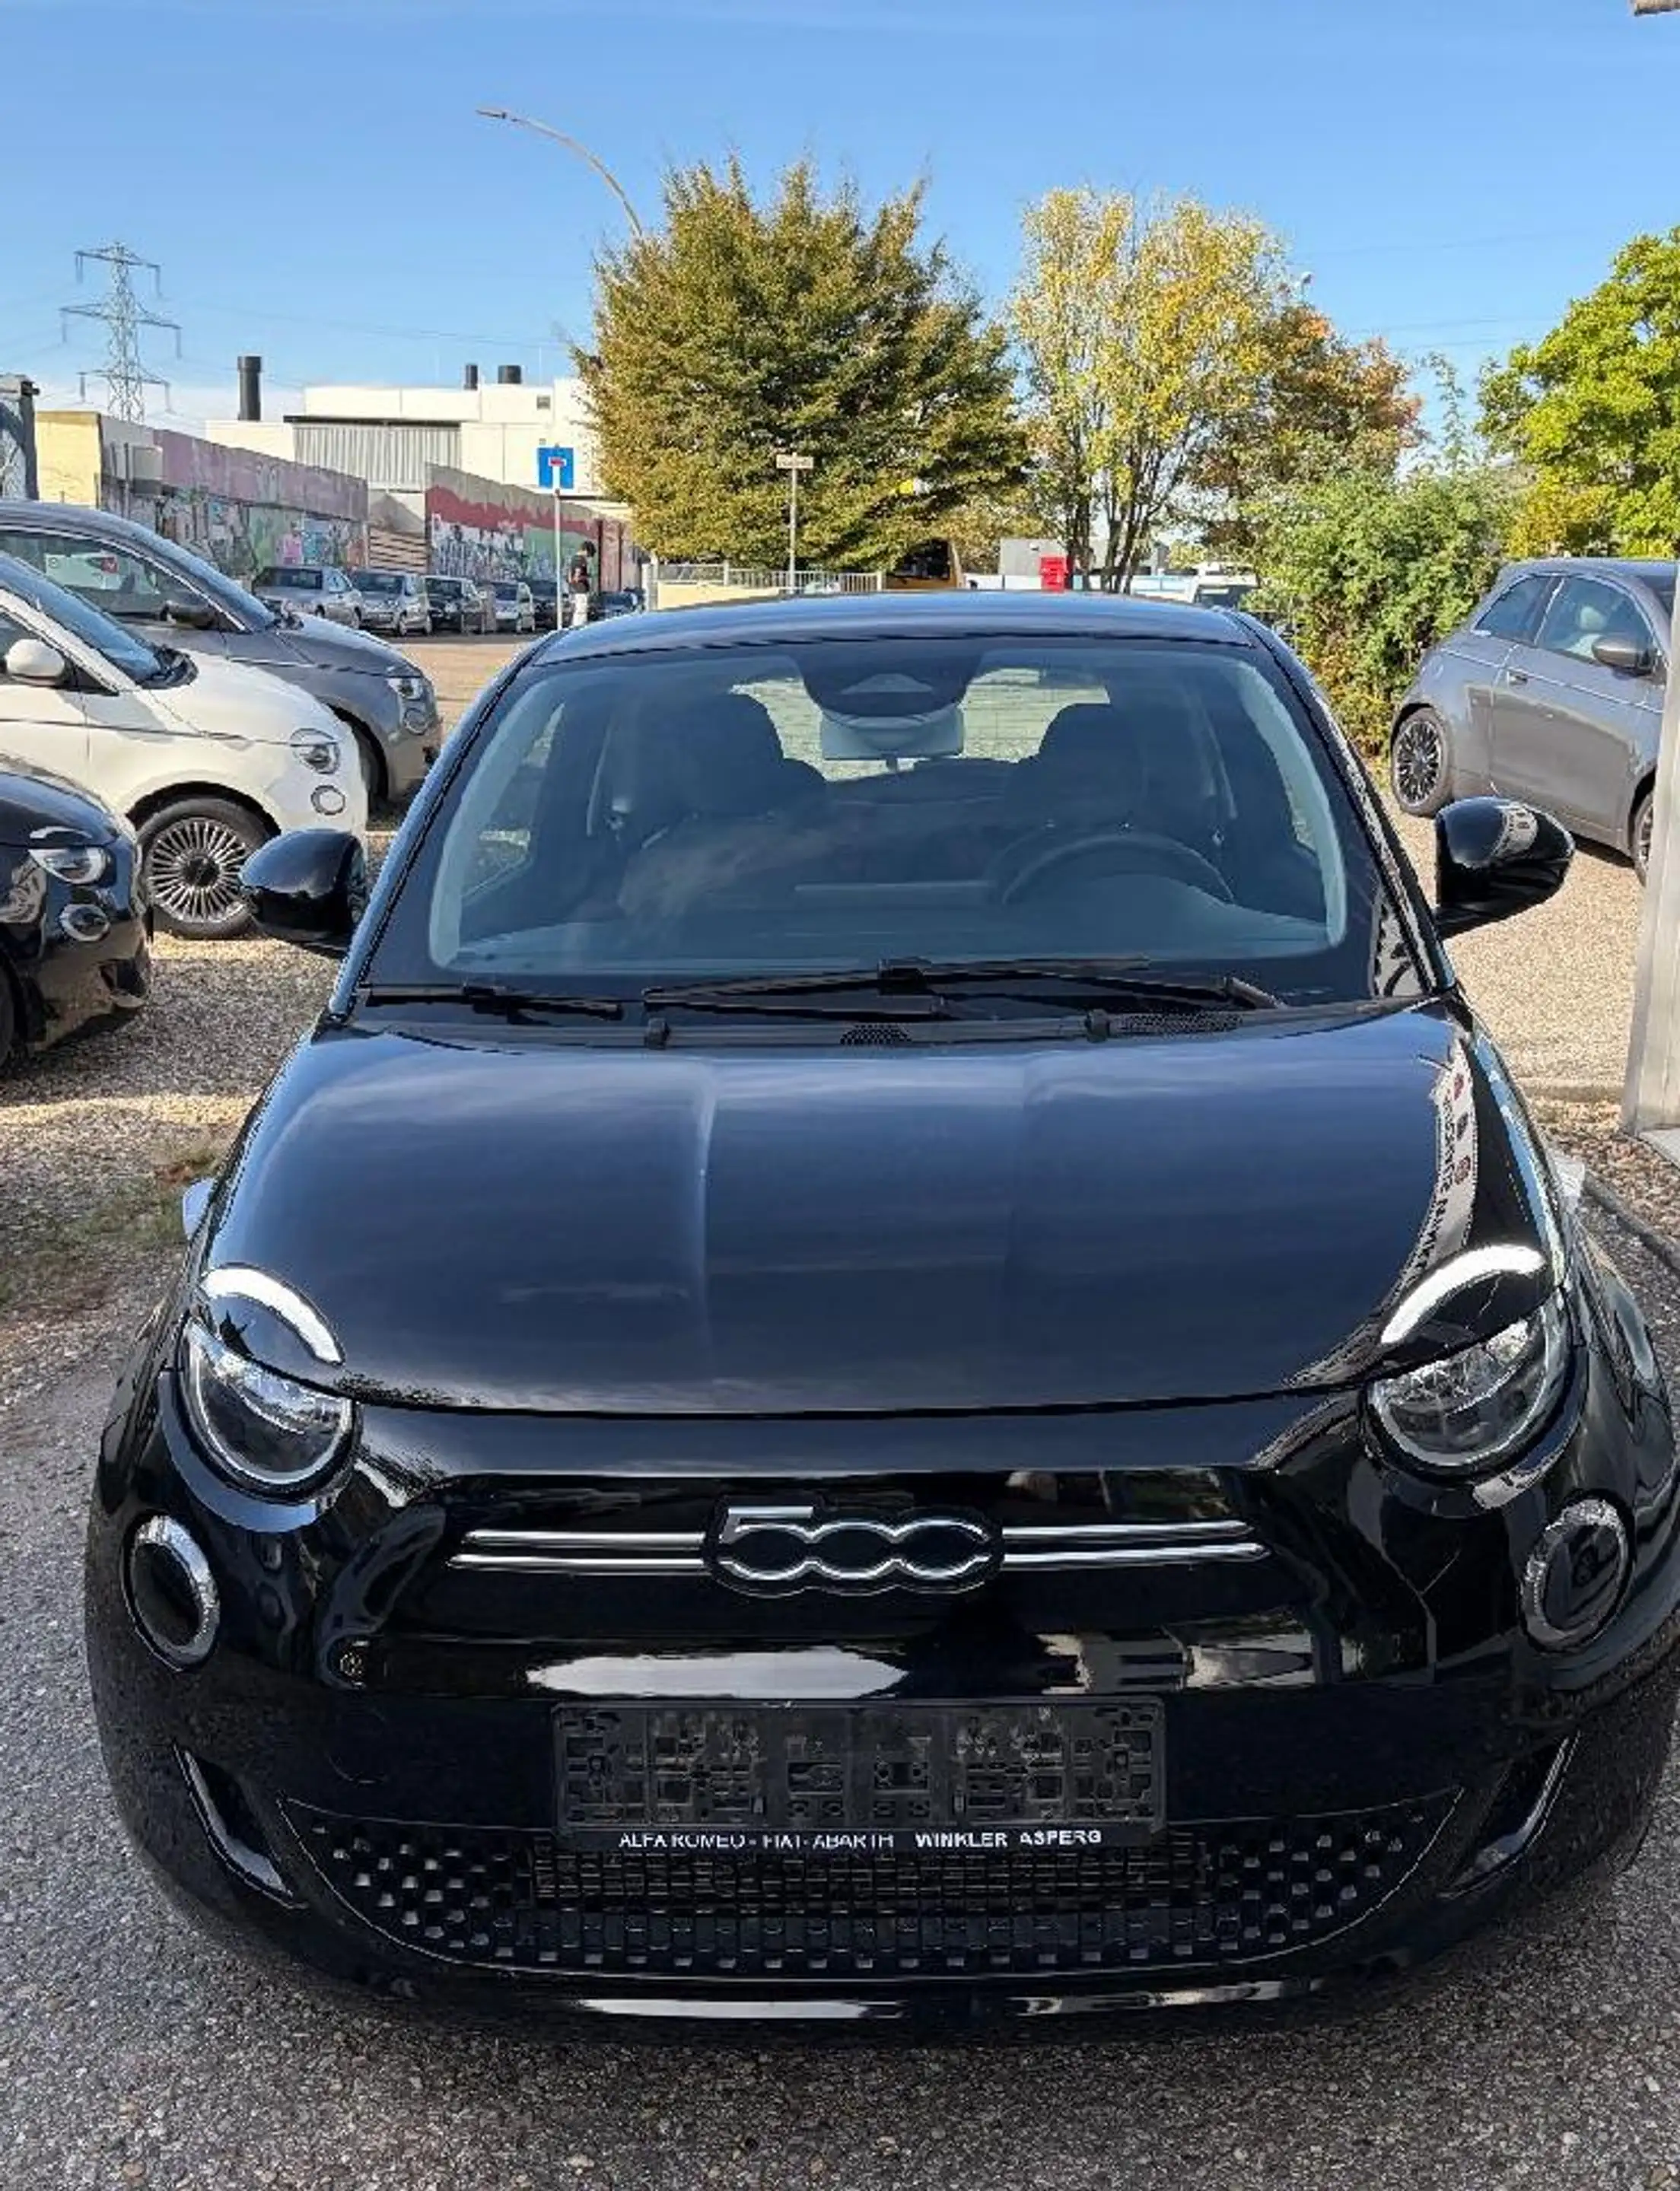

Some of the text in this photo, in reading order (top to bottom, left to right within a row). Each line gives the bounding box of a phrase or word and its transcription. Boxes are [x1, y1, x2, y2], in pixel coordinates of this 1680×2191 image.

[719, 1506, 991, 1580] 500
[619, 1833, 667, 1848] ALFA
[671, 1833, 745, 1849] ROMEO
[915, 1832, 1008, 1848] WINKLER
[1020, 1830, 1102, 1846] ASPERG
